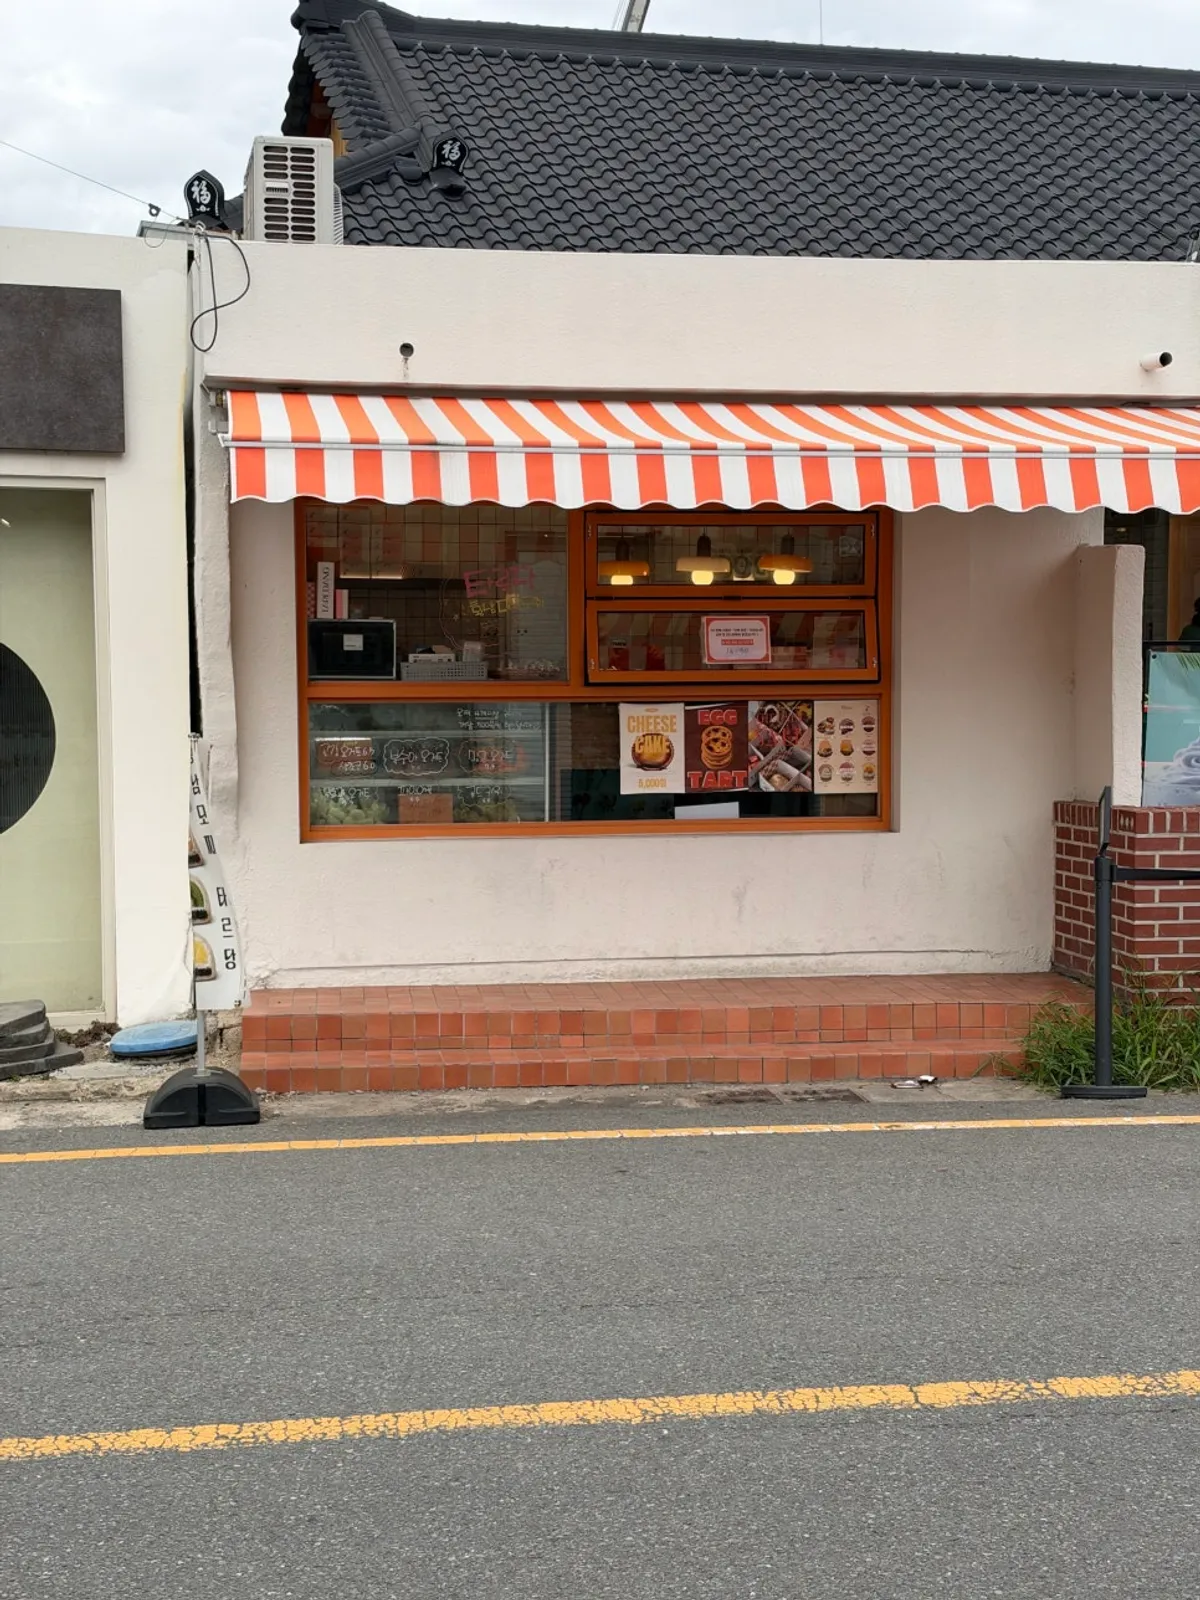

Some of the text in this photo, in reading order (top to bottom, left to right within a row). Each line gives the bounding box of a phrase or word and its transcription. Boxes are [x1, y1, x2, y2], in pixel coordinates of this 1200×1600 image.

[441, 140, 461, 160] 福
[191, 180, 211, 205] 福
[627, 715, 677, 734] CHEESE
[697, 709, 738, 726] EGG
[634, 735, 671, 753] CAKE
[687, 770, 748, 789] TART
